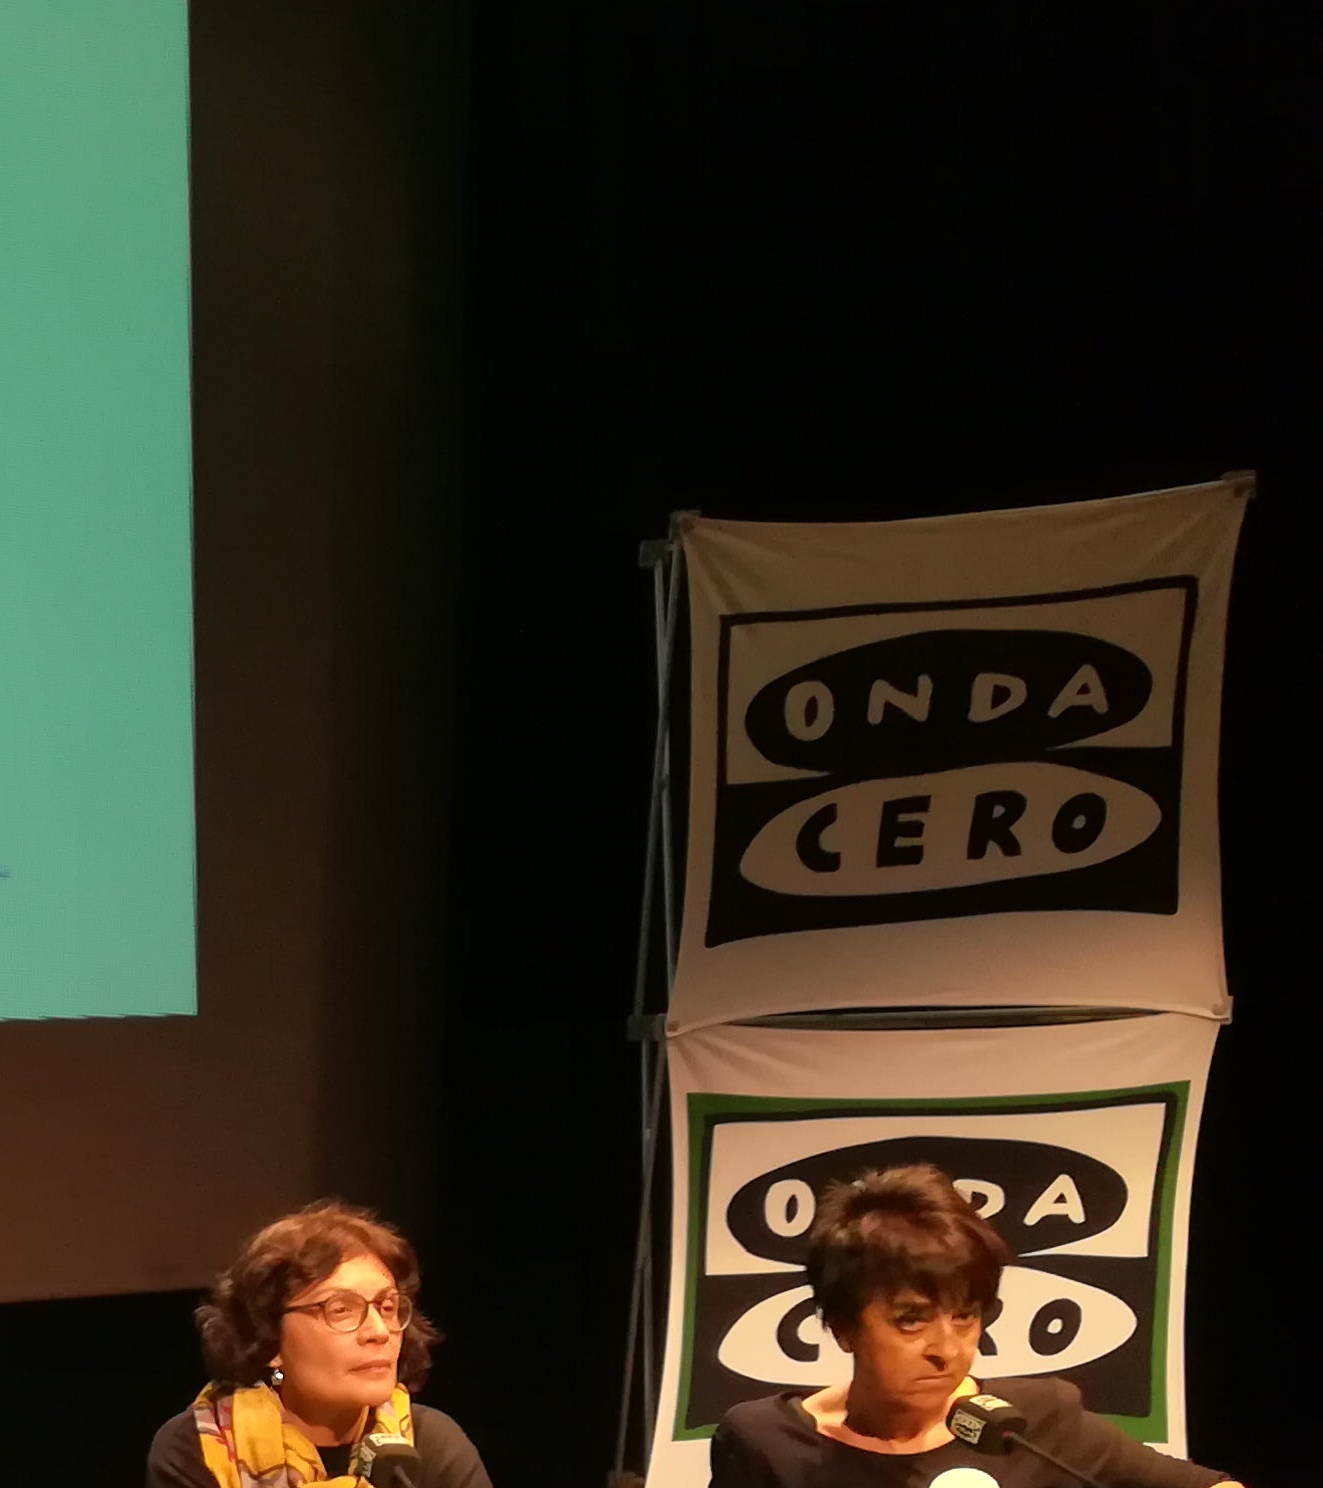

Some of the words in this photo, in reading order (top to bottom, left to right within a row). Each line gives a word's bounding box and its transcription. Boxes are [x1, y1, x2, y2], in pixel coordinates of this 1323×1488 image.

[783, 663, 1109, 742] ONDA
[795, 789, 1108, 873] CERO
[763, 1173, 1086, 1238] ODA
